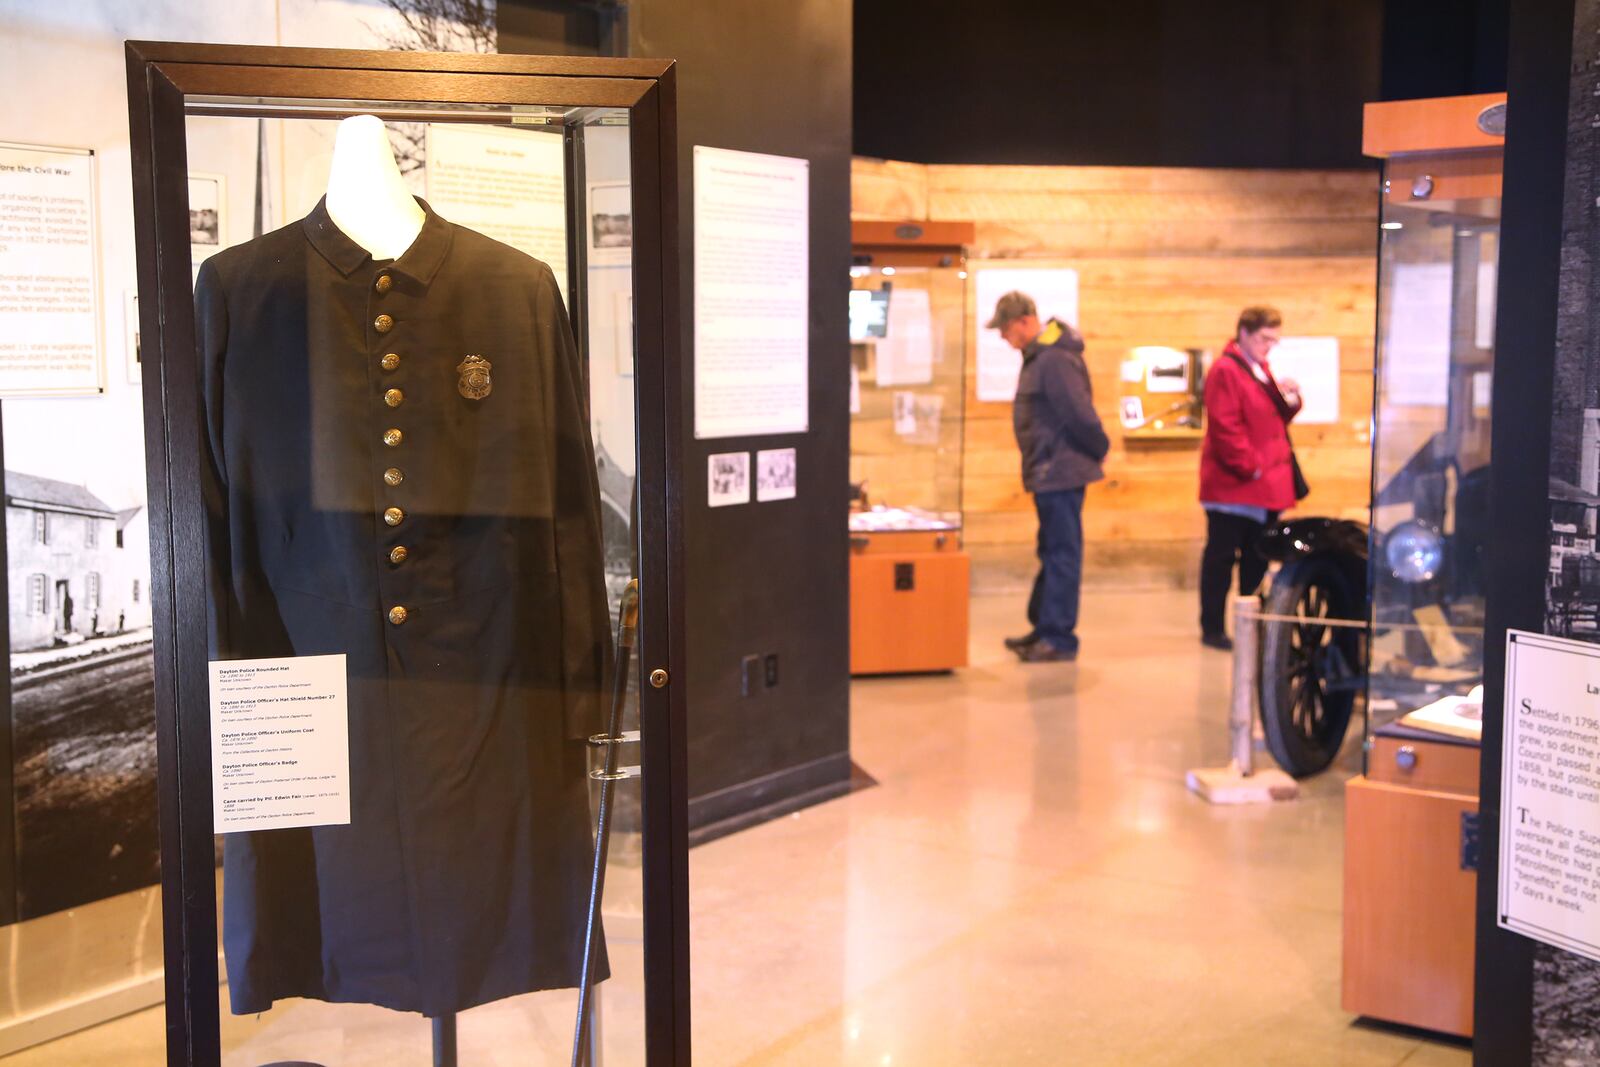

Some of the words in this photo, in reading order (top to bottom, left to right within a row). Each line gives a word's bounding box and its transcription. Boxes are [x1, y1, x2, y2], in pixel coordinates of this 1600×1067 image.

[17, 165, 32, 173] the
[34, 166, 52, 174] Civil
[55, 168, 71, 176] War
[1587, 683, 1600, 695] La
[1520, 698, 1559, 721] Settled
[1562, 713, 1571, 723] in
[1519, 719, 1534, 730] the
[1537, 724, 1598, 744] appointment
[1519, 734, 1544, 748] grew,
[1547, 741, 1558, 750] so
[1560, 742, 1575, 754] did
[1578, 746, 1594, 758] the
[1519, 746, 1552, 762] Council
[1557, 757, 1591, 772] passed
[1519, 760, 1544, 776] 1858,
[1548, 768, 1564, 779] but
[1517, 773, 1532, 787] by
[1533, 776, 1548, 792] the
[1549, 780, 1574, 798] state
[1577, 788, 1600, 804] until
[1517, 806, 1541, 828] The
[1546, 821, 1573, 837] Police
[1516, 828, 1554, 845] oversaw
[1558, 841, 1570, 849] all
[1515, 842, 1541, 856] police
[1546, 849, 1569, 865] force
[1574, 859, 1592, 872] had
[1515, 854, 1562, 876] Patrolmen
[1565, 872, 1588, 885] were
[1522, 886, 1544, 900] days
[1557, 898, 1584, 913] week.
[1562, 884, 1578, 896] did
[1581, 890, 1597, 903] not
